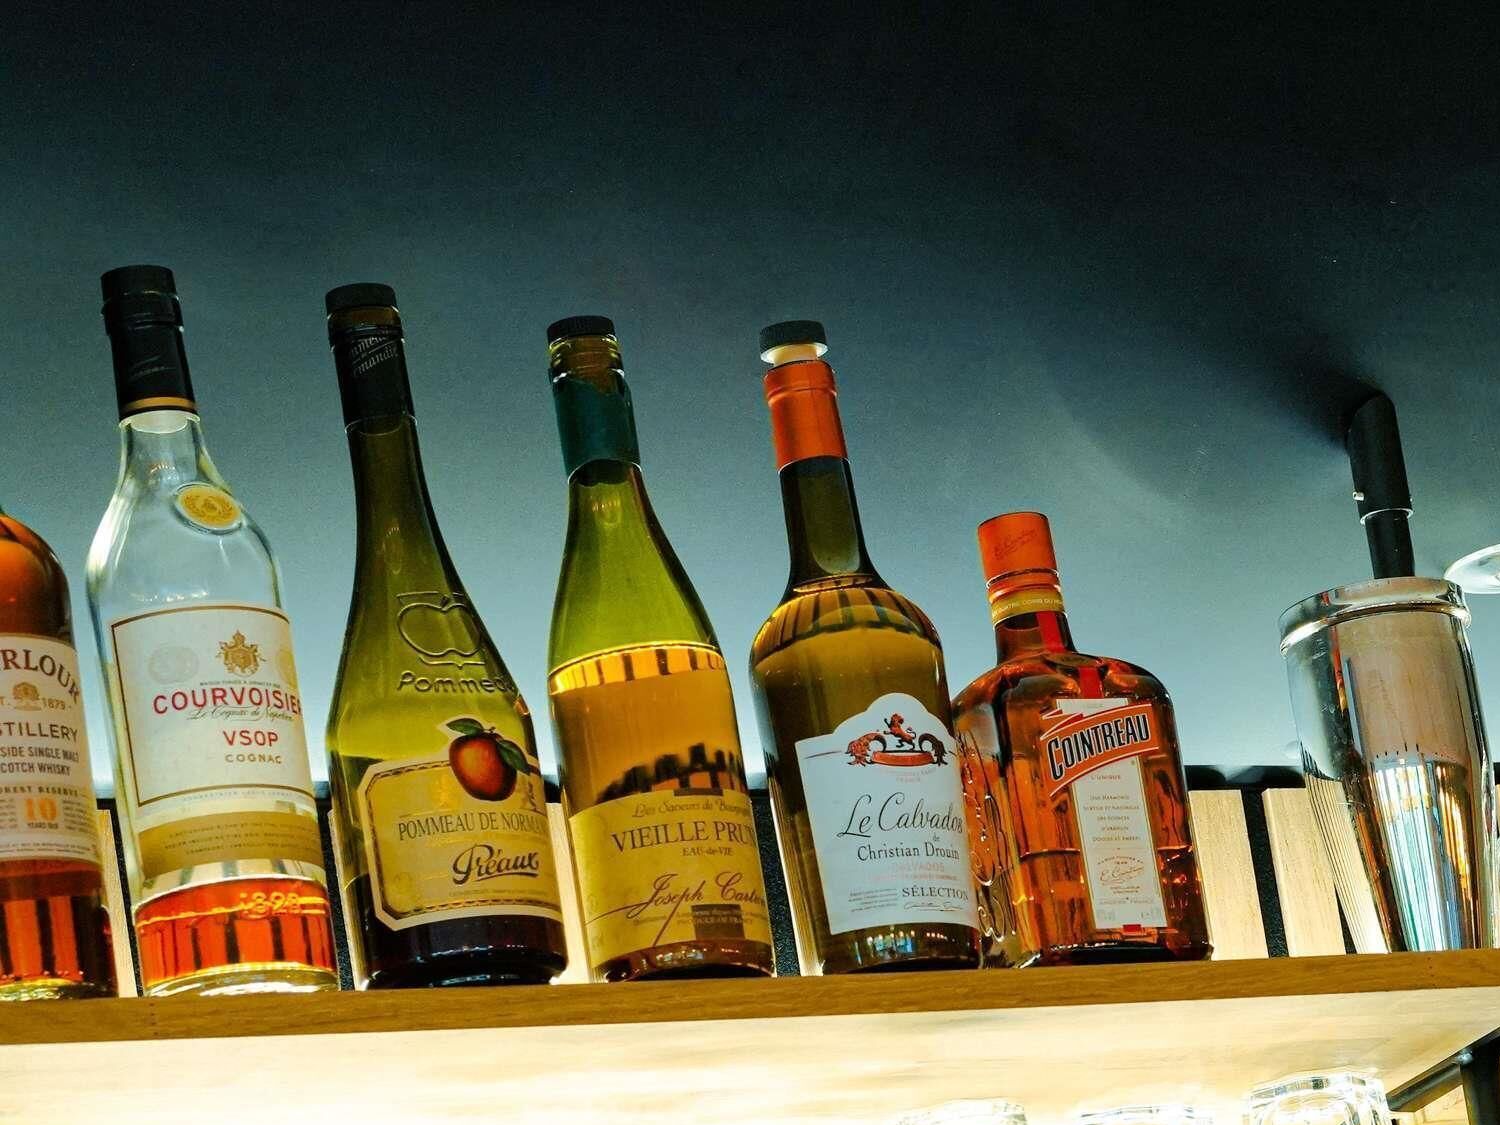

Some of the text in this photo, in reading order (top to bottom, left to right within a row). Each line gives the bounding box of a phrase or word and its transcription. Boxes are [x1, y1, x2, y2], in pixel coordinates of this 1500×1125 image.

[222, 730, 278, 747] VSOP
[1047, 713, 1151, 782] COINTREAU
[27, 747, 61, 759] SINGLE
[225, 753, 282, 765] COGNAC
[37, 762, 71, 776] WHISKY
[839, 791, 963, 838] Le Calvados
[398, 812, 474, 841] POMMEAU
[479, 811, 499, 830] DE
[611, 821, 709, 853] VIEILLE
[857, 841, 961, 862] Christian Drouin
